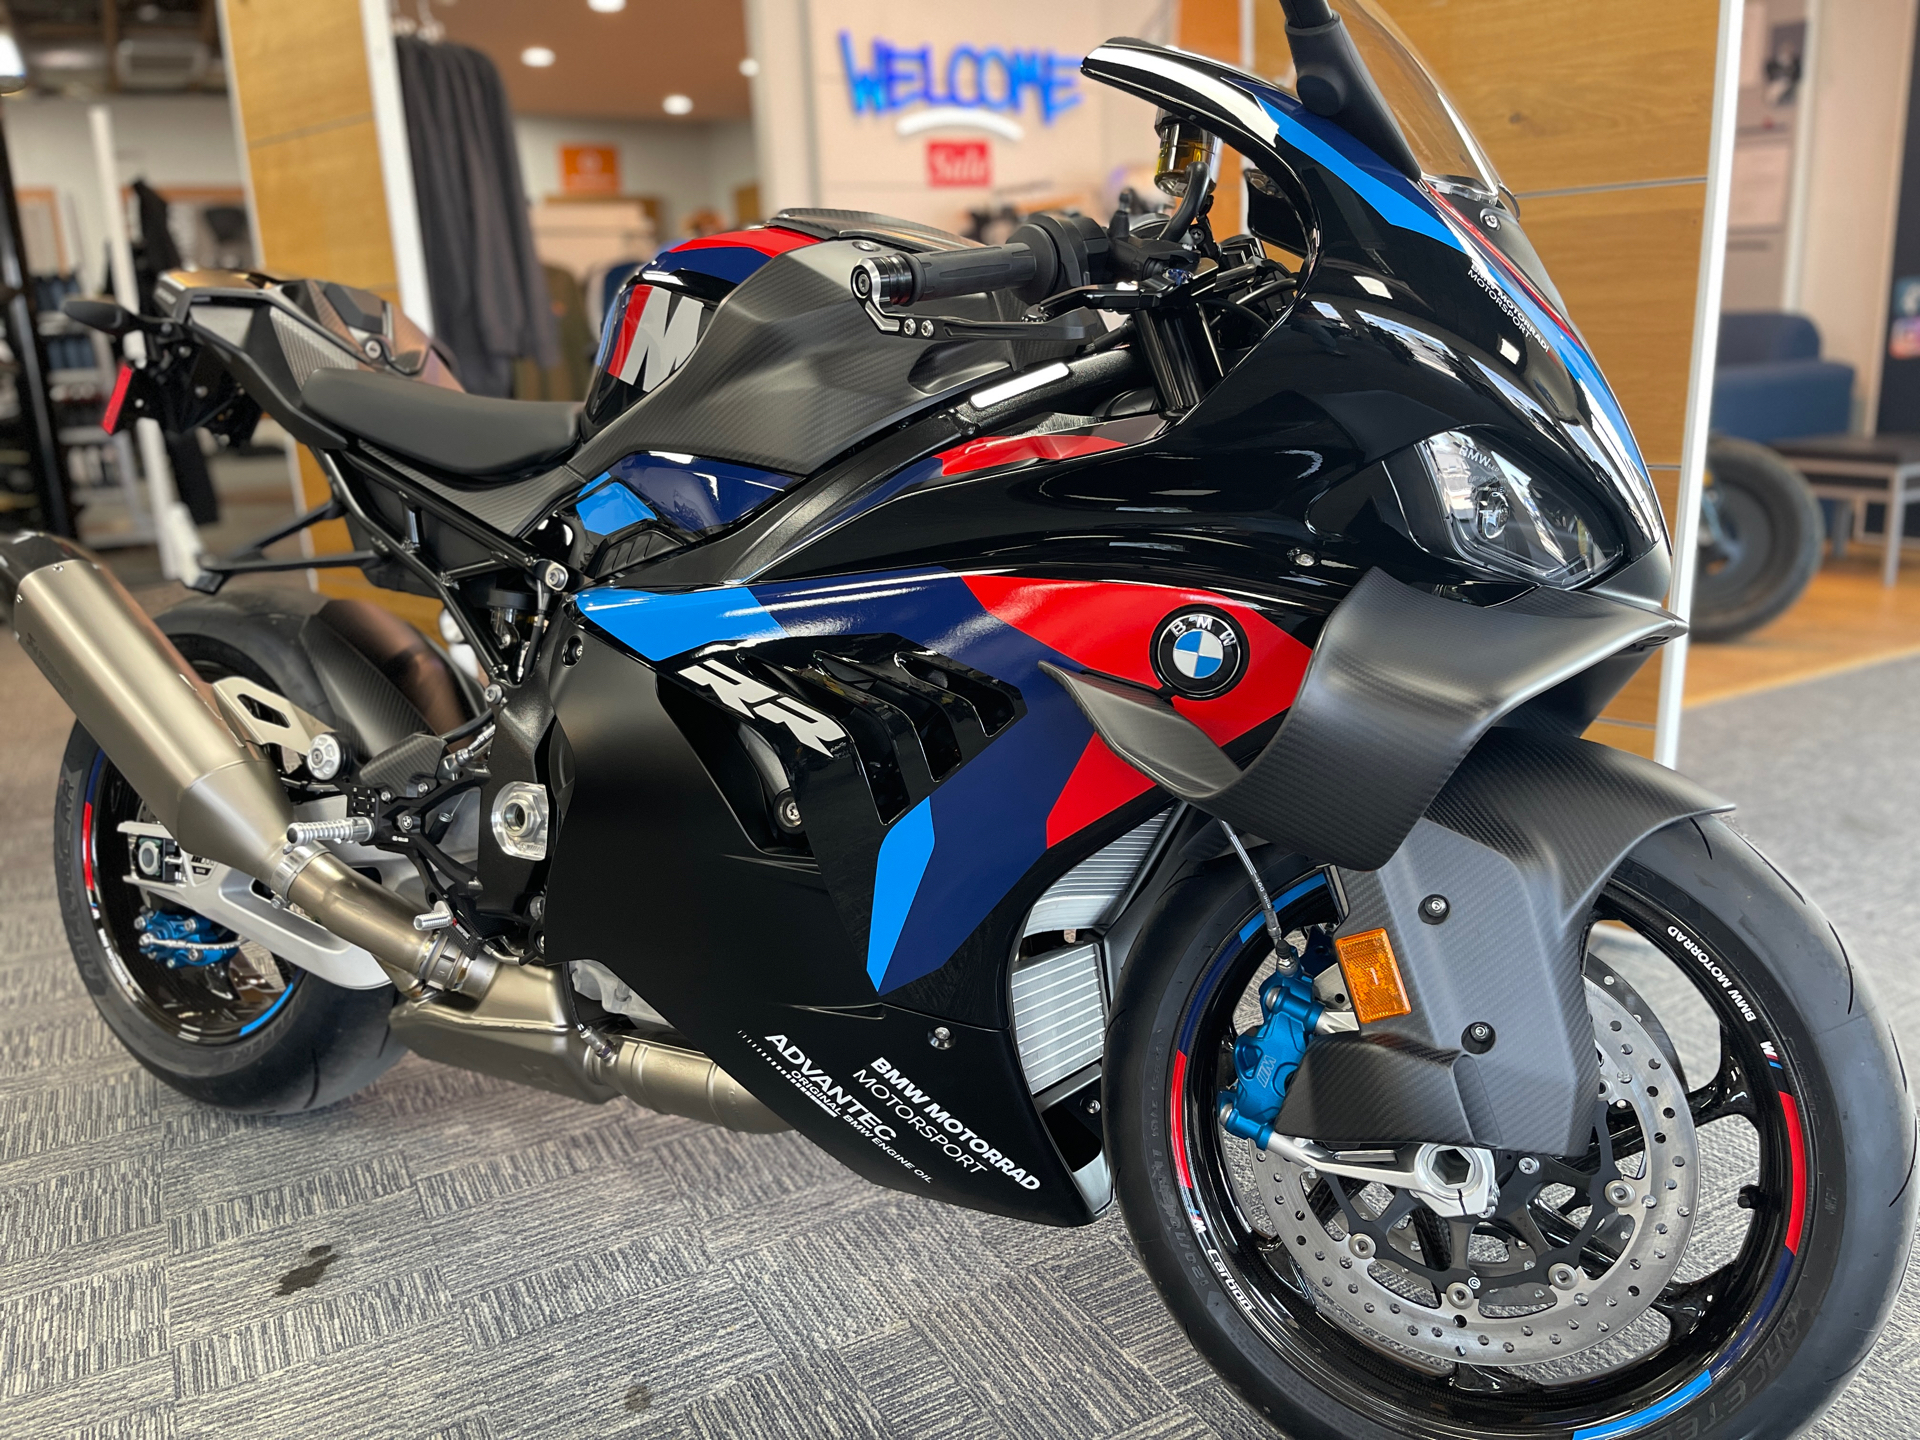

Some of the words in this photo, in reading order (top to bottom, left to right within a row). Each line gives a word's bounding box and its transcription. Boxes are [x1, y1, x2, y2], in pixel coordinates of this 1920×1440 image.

[838, 32, 1085, 125] WELCOME
[619, 285, 704, 393] M
[1468, 269, 1531, 338] MOTORSPORT
[1497, 287, 1548, 351] MOTORRAD
[1459, 445, 1491, 467] BMW
[1170, 616, 1236, 647] BMW
[677, 659, 847, 759] RR
[1667, 925, 1733, 988] MOTORRAD
[1727, 989, 1757, 1022] BMW
[764, 1034, 897, 1141] ADVANTEC
[790, 1069, 842, 1116] ORIGINAL
[842, 1114, 874, 1137] BMW
[871, 1136, 916, 1170] ENGINE
[913, 1168, 934, 1184] OIL
[852, 1069, 988, 1173] MOTORSPORT
[870, 1056, 931, 1104] BMW
[923, 1102, 1041, 1190] MOTORRAD
[1207, 1248, 1255, 1311] Carbon
